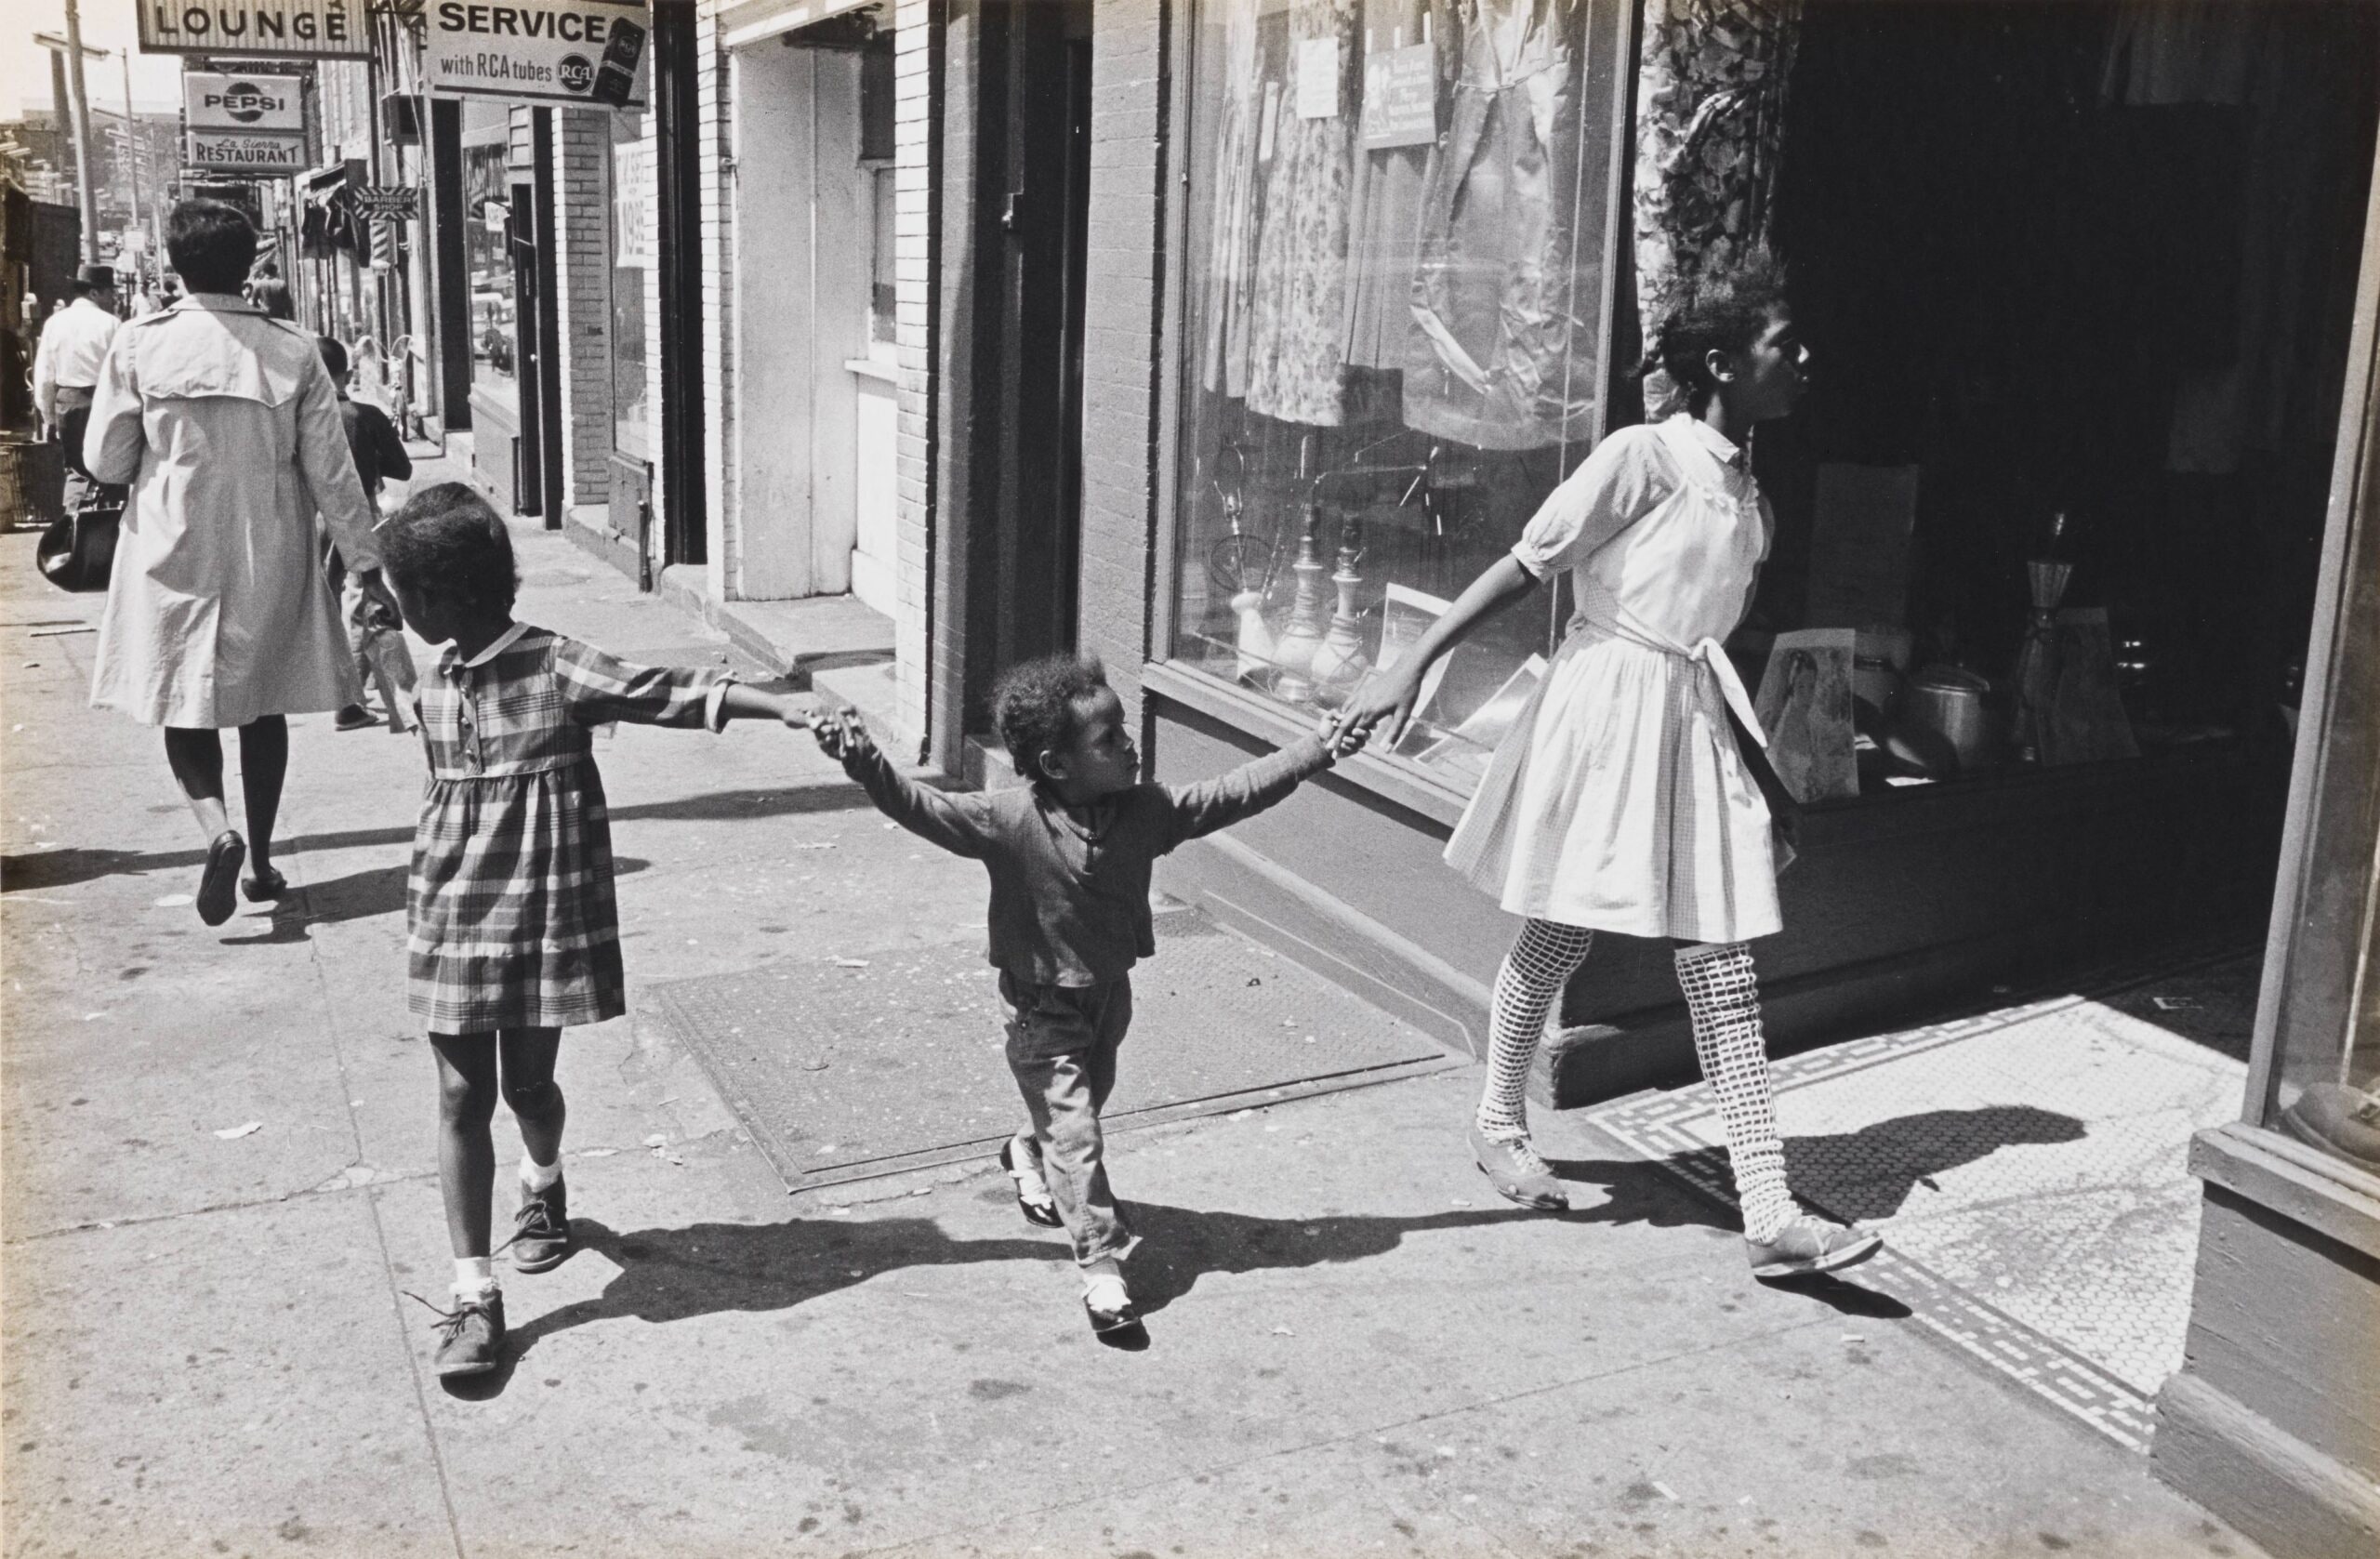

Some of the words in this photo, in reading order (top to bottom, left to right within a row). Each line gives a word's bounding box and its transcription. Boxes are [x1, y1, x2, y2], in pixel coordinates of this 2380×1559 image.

[157, 6, 348, 41] LOUNGE
[438, 2, 606, 44] SERVICE
[441, 54, 473, 74] with
[477, 53, 510, 79] RCA
[512, 62, 552, 82] tubes
[560, 64, 593, 82] RCA
[205, 94, 284, 111] PEPSI
[196, 142, 298, 164] RESTAURANT
[374, 204, 403, 212] SHOP
